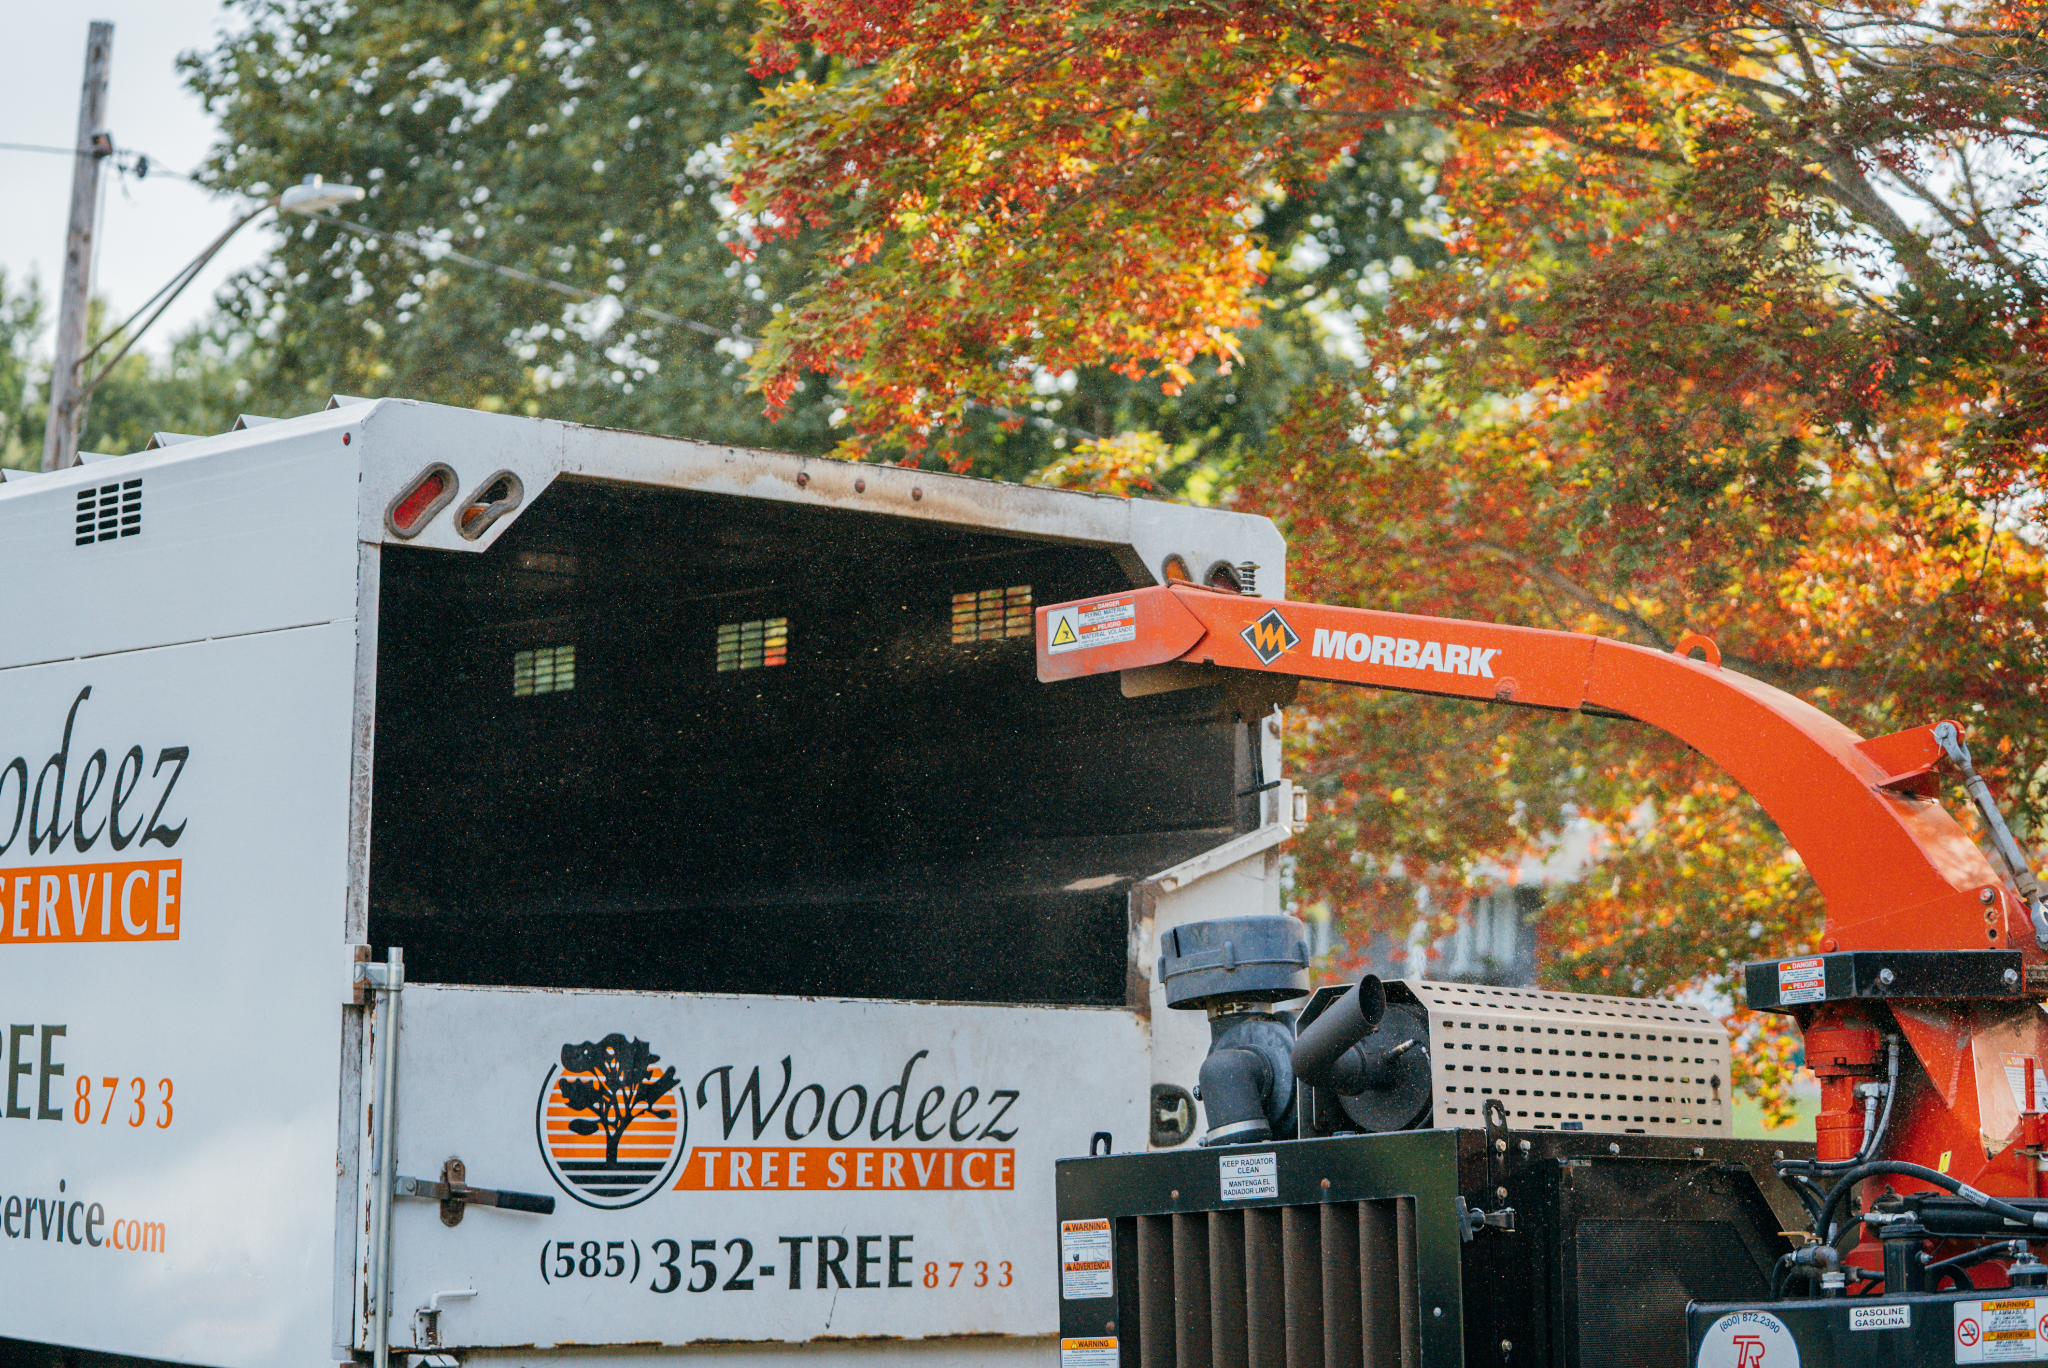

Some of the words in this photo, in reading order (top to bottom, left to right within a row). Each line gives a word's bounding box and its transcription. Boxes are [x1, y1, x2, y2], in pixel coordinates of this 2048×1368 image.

[1097, 600, 1120, 609] DANGER
[1084, 610, 1102, 619] FLYING
[1103, 606, 1128, 615] MATERIAL
[1097, 620, 1121, 630] PELIGRO
[1081, 630, 1106, 640] MATERIAL
[1108, 625, 1133, 635] VOLANDO
[1311, 628, 1497, 679] MORBARK
[1792, 960, 1818, 969] DANGER
[1793, 981, 1819, 989] PELIGRO
[0, 1023, 68, 1121] EE
[74, 1075, 174, 1129] 8733
[696, 1049, 1020, 1143] Woodeez
[1240, 1157, 1274, 1166] RADIATOR
[697, 1151, 807, 1188] TREE
[827, 1152, 1012, 1188] SERVICE
[1237, 1166, 1260, 1174] CLEAN
[1228, 1179, 1262, 1187] MANTENGA
[1262, 1178, 1271, 1186] EL
[1223, 1187, 1255, 1196] RADIADOR
[1255, 1186, 1275, 1194] LIMPIO
[0, 1179, 165, 1253] ervice.com
[1072, 1221, 1107, 1231] WARNING
[540, 1238, 641, 1285] (585)
[649, 1234, 914, 1293] 352-TREE
[922, 1260, 1014, 1288] 8733
[1073, 1261, 1110, 1271] ADVERTENCIA
[1995, 1300, 2030, 1309] WARNING
[1855, 1307, 1905, 1317] GASOLINE
[1719, 1315, 1740, 1332] (800)
[1742, 1313, 1781, 1334] 872.2390
[1855, 1317, 1905, 1327] GASOLINA
[1996, 1331, 2030, 1339] ADVERTENCIA
[1077, 1340, 1109, 1348] WARNING
